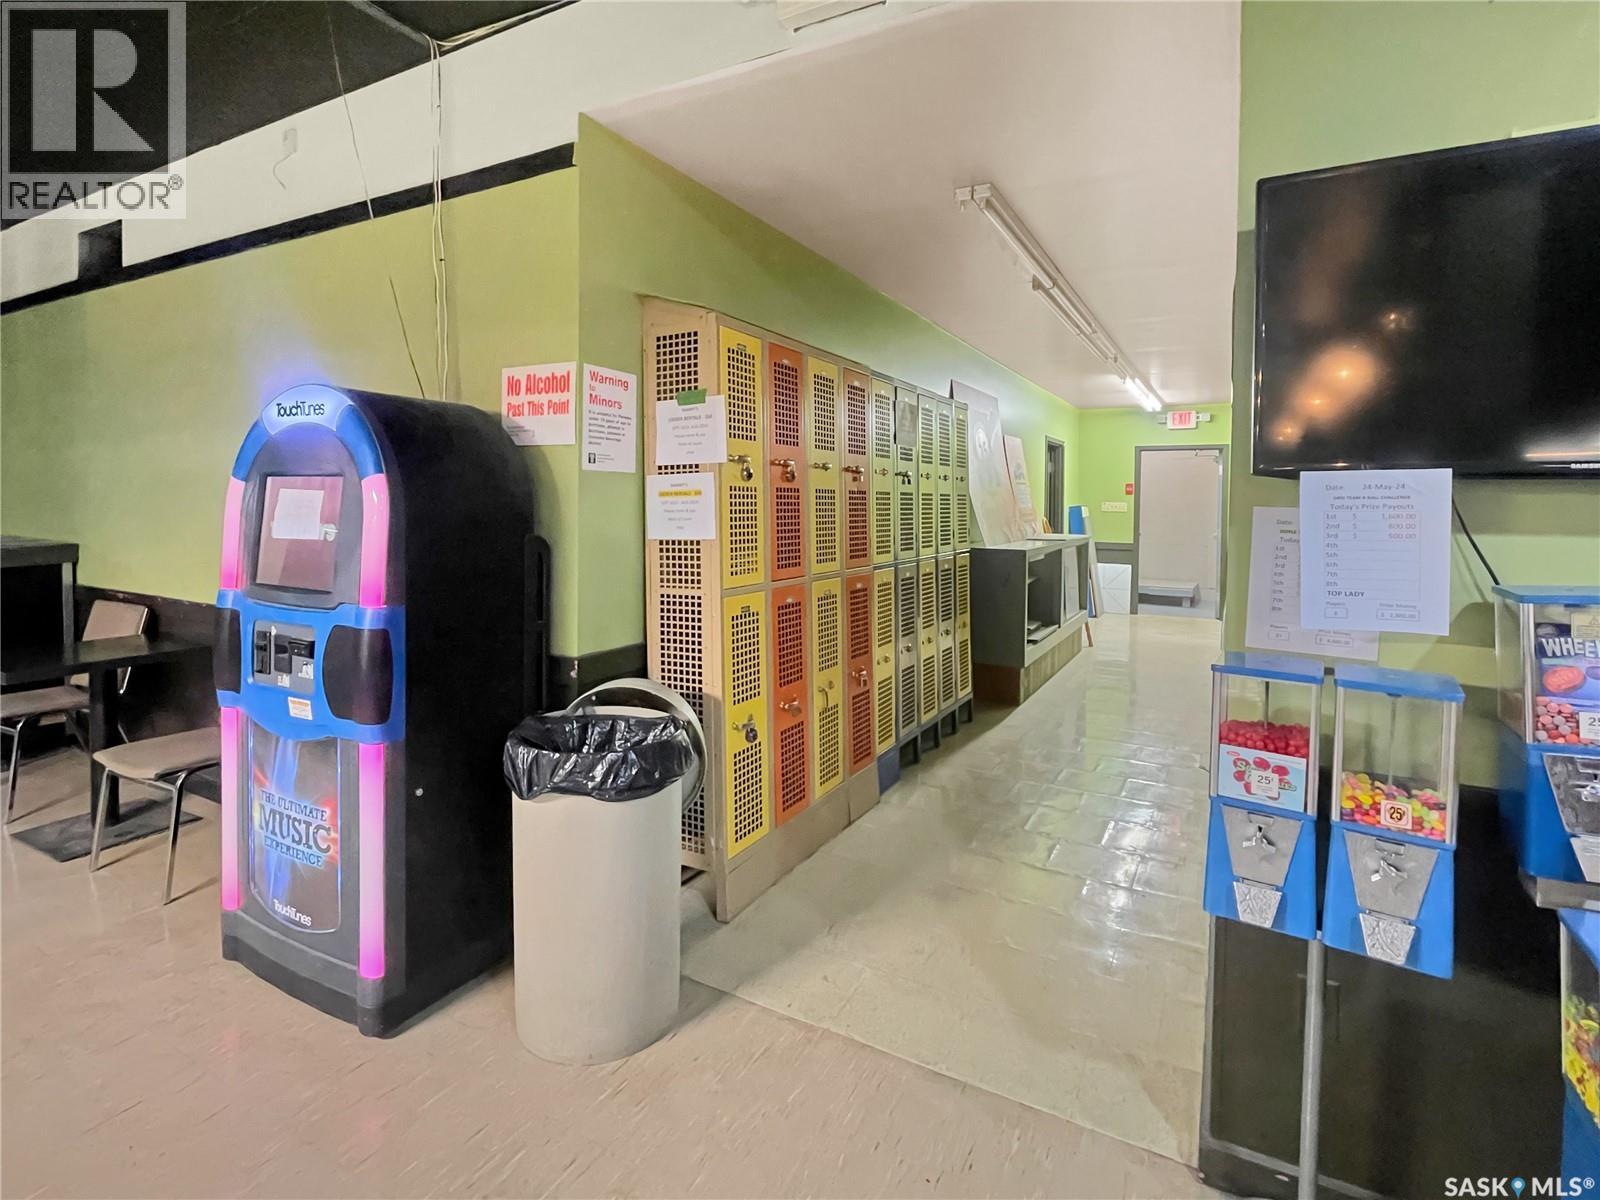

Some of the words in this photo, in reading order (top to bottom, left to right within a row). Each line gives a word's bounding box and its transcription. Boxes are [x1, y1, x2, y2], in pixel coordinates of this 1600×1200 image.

[507, 375, 521, 397] No
[525, 370, 570, 395] Alcohol
[589, 370, 629, 391] Warning
[589, 384, 596, 392] to
[276, 400, 325, 418] TouchTunes
[507, 402, 524, 418] Past
[527, 400, 544, 417] This
[547, 399, 570, 415] Point
[589, 393, 623, 410] Minors
[1172, 412, 1192, 426] EXIT
[1382, 503, 1414, 511] Payouts
[1541, 637, 1600, 658] WHEE
[260, 790, 276, 806] THE
[278, 797, 327, 822] ULTIMATE
[259, 803, 332, 854] MUSIC
[264, 836, 323, 867] EXPERIENCE
[273, 899, 312, 927] TouchTunes
